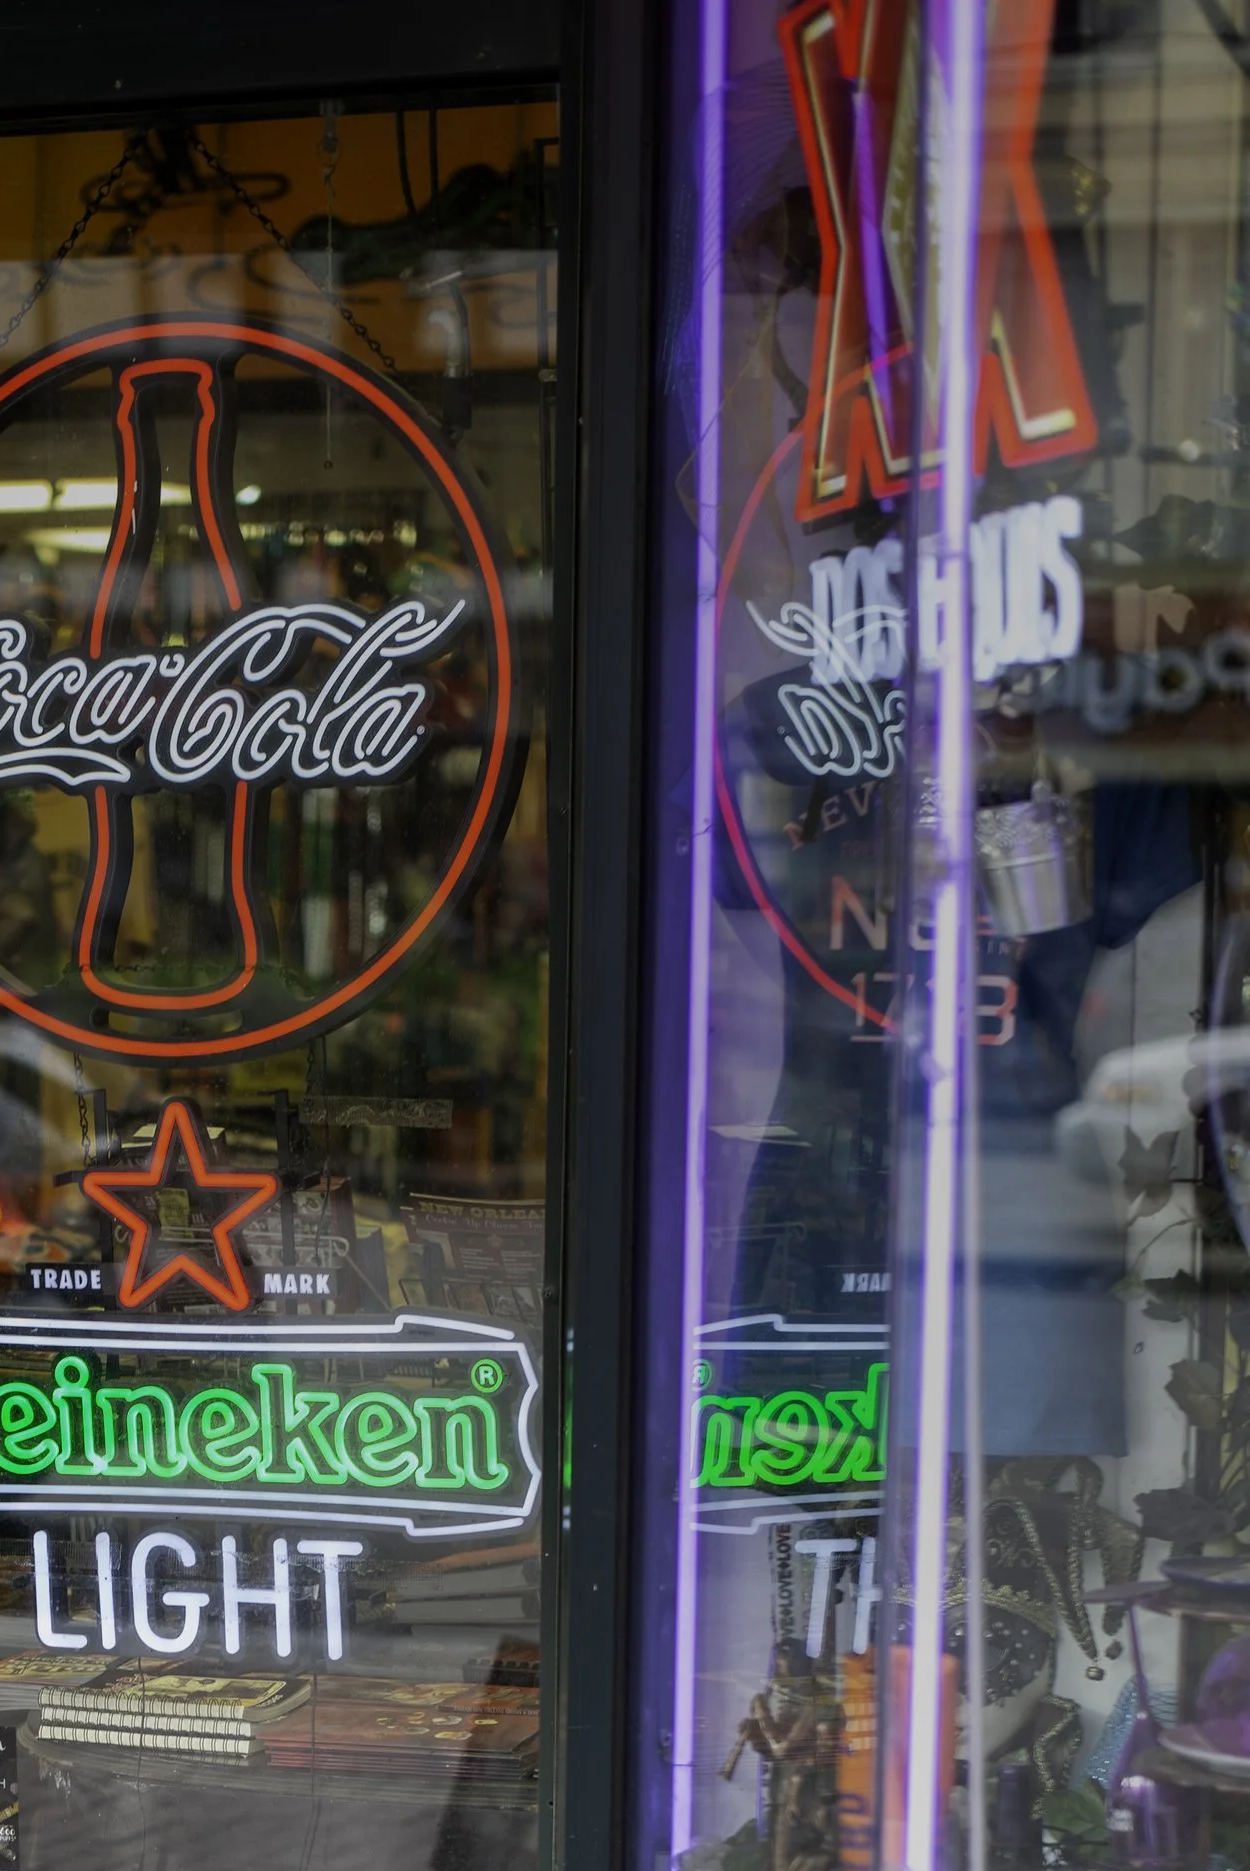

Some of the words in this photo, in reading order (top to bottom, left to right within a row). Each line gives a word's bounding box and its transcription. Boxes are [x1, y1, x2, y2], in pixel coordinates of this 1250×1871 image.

[419, 1201, 464, 1216] NEW
[31, 1267, 102, 1291] TRADE
[264, 1272, 331, 1295] MARK
[32, 1530, 364, 1661] LIGHT
